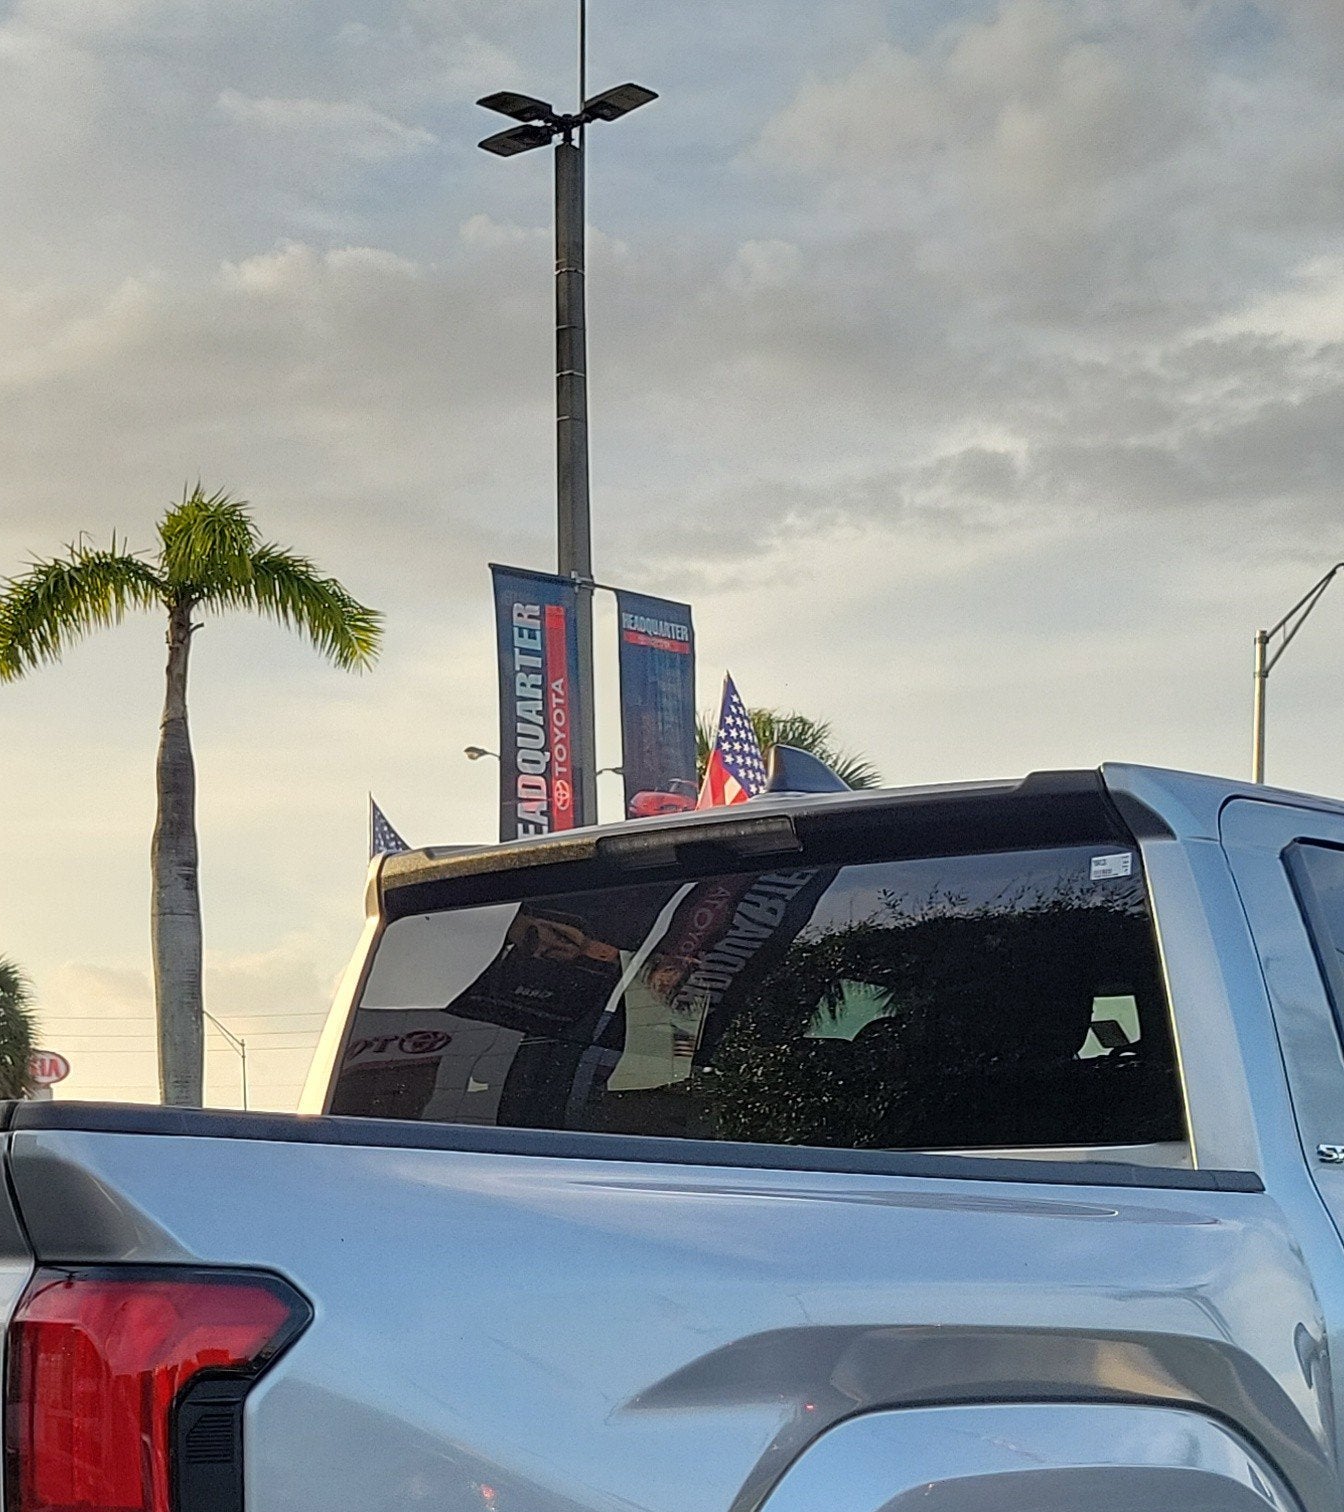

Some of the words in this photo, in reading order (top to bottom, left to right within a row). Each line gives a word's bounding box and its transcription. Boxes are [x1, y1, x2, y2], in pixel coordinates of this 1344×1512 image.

[622, 612, 689, 642] HEADQUARTER
[512, 602, 551, 839] EADQUARTER
[551, 678, 568, 776] TOYOTA
